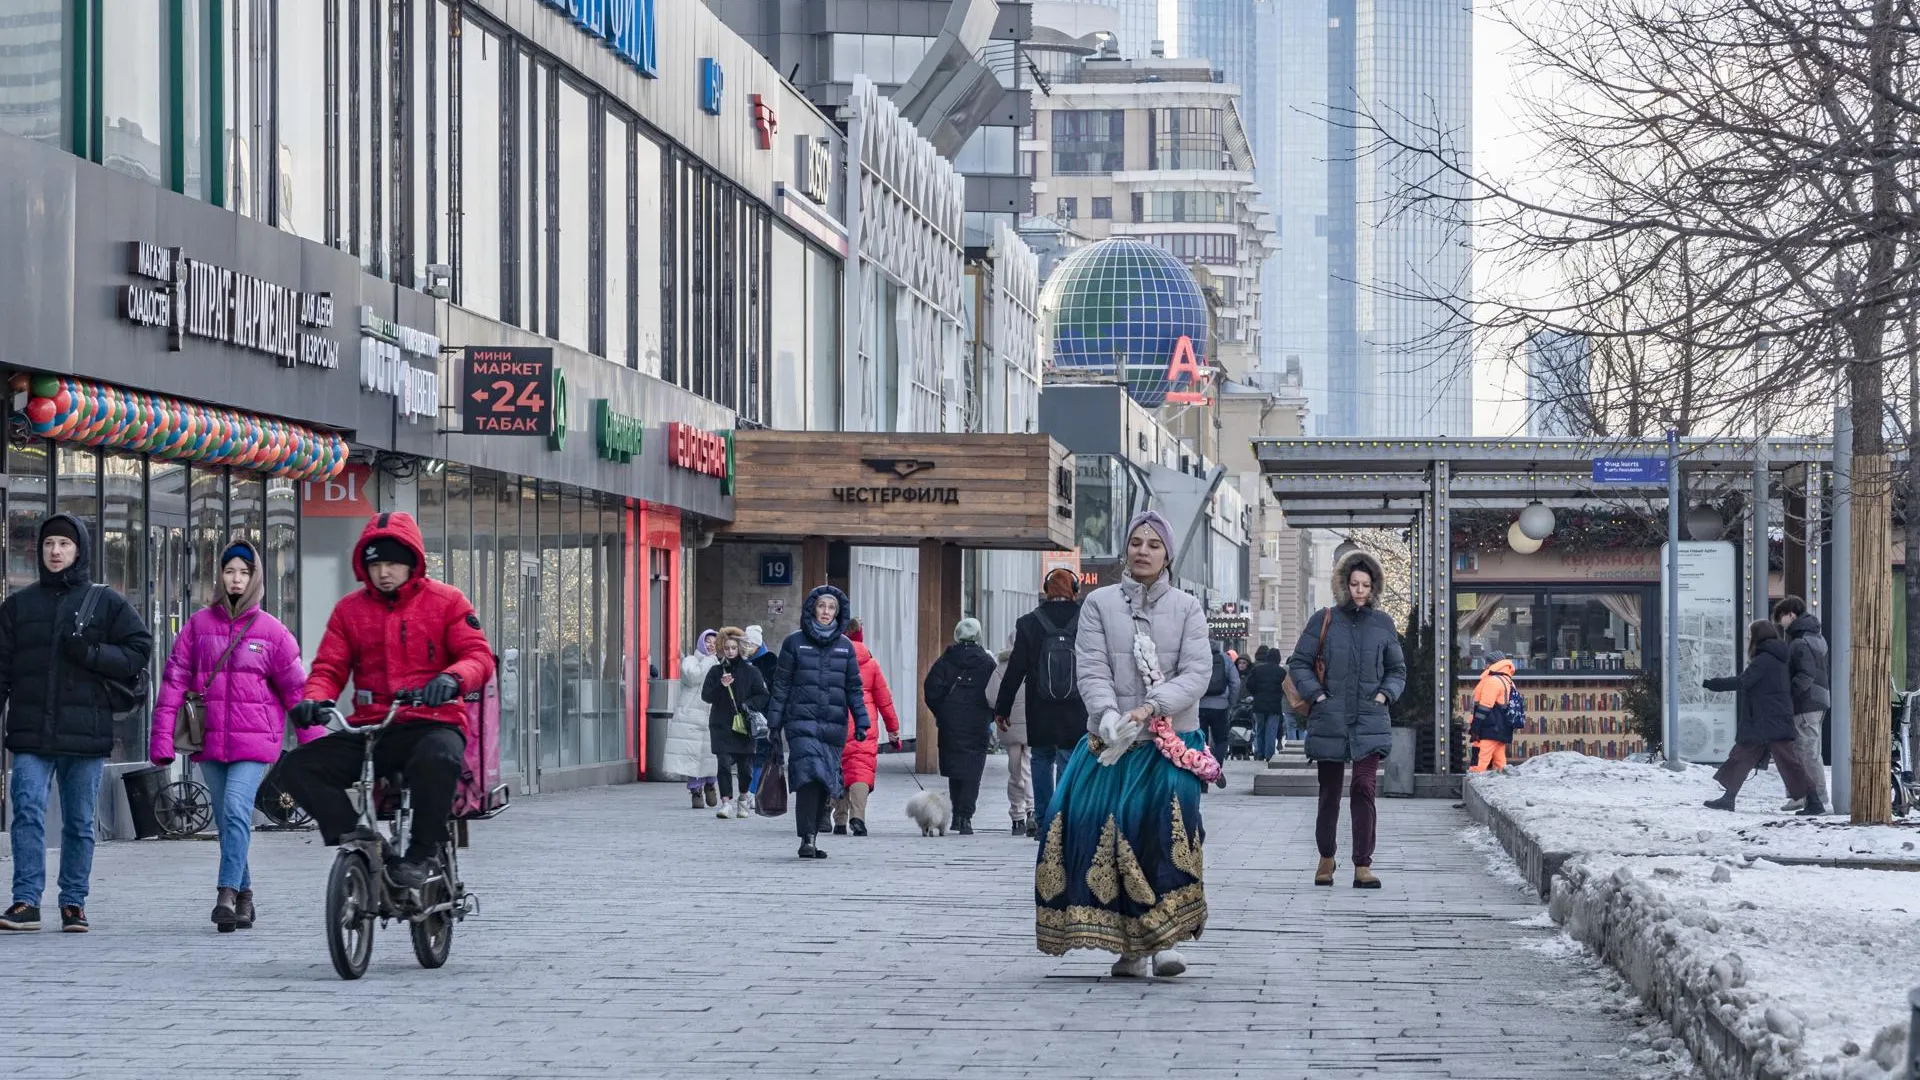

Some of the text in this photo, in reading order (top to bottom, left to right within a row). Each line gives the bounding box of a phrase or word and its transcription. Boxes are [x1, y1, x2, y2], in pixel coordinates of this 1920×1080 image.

[139, 241, 170, 281] МАГАЗИН
[128, 285, 170, 328] СЛАДОСТЕЙ
[189, 260, 297, 368] ПИРАТ-МАРМЕЛАД
[301, 292, 315, 326] ДЛЯ
[315, 292, 334, 329] ДЕТЕЙ
[305, 335, 339, 370] ВЗРОСЛЫХ
[473, 351, 512, 361] МИНИ
[473, 362, 543, 375] МАРКЕТ
[490, 380, 545, 413] 24
[476, 416, 538, 431] ТАБАК
[677, 421, 727, 479] EUROSPAR
[832, 486, 960, 505] ЧЕСТЕРФИЛД
[767, 562, 785, 578] 19
